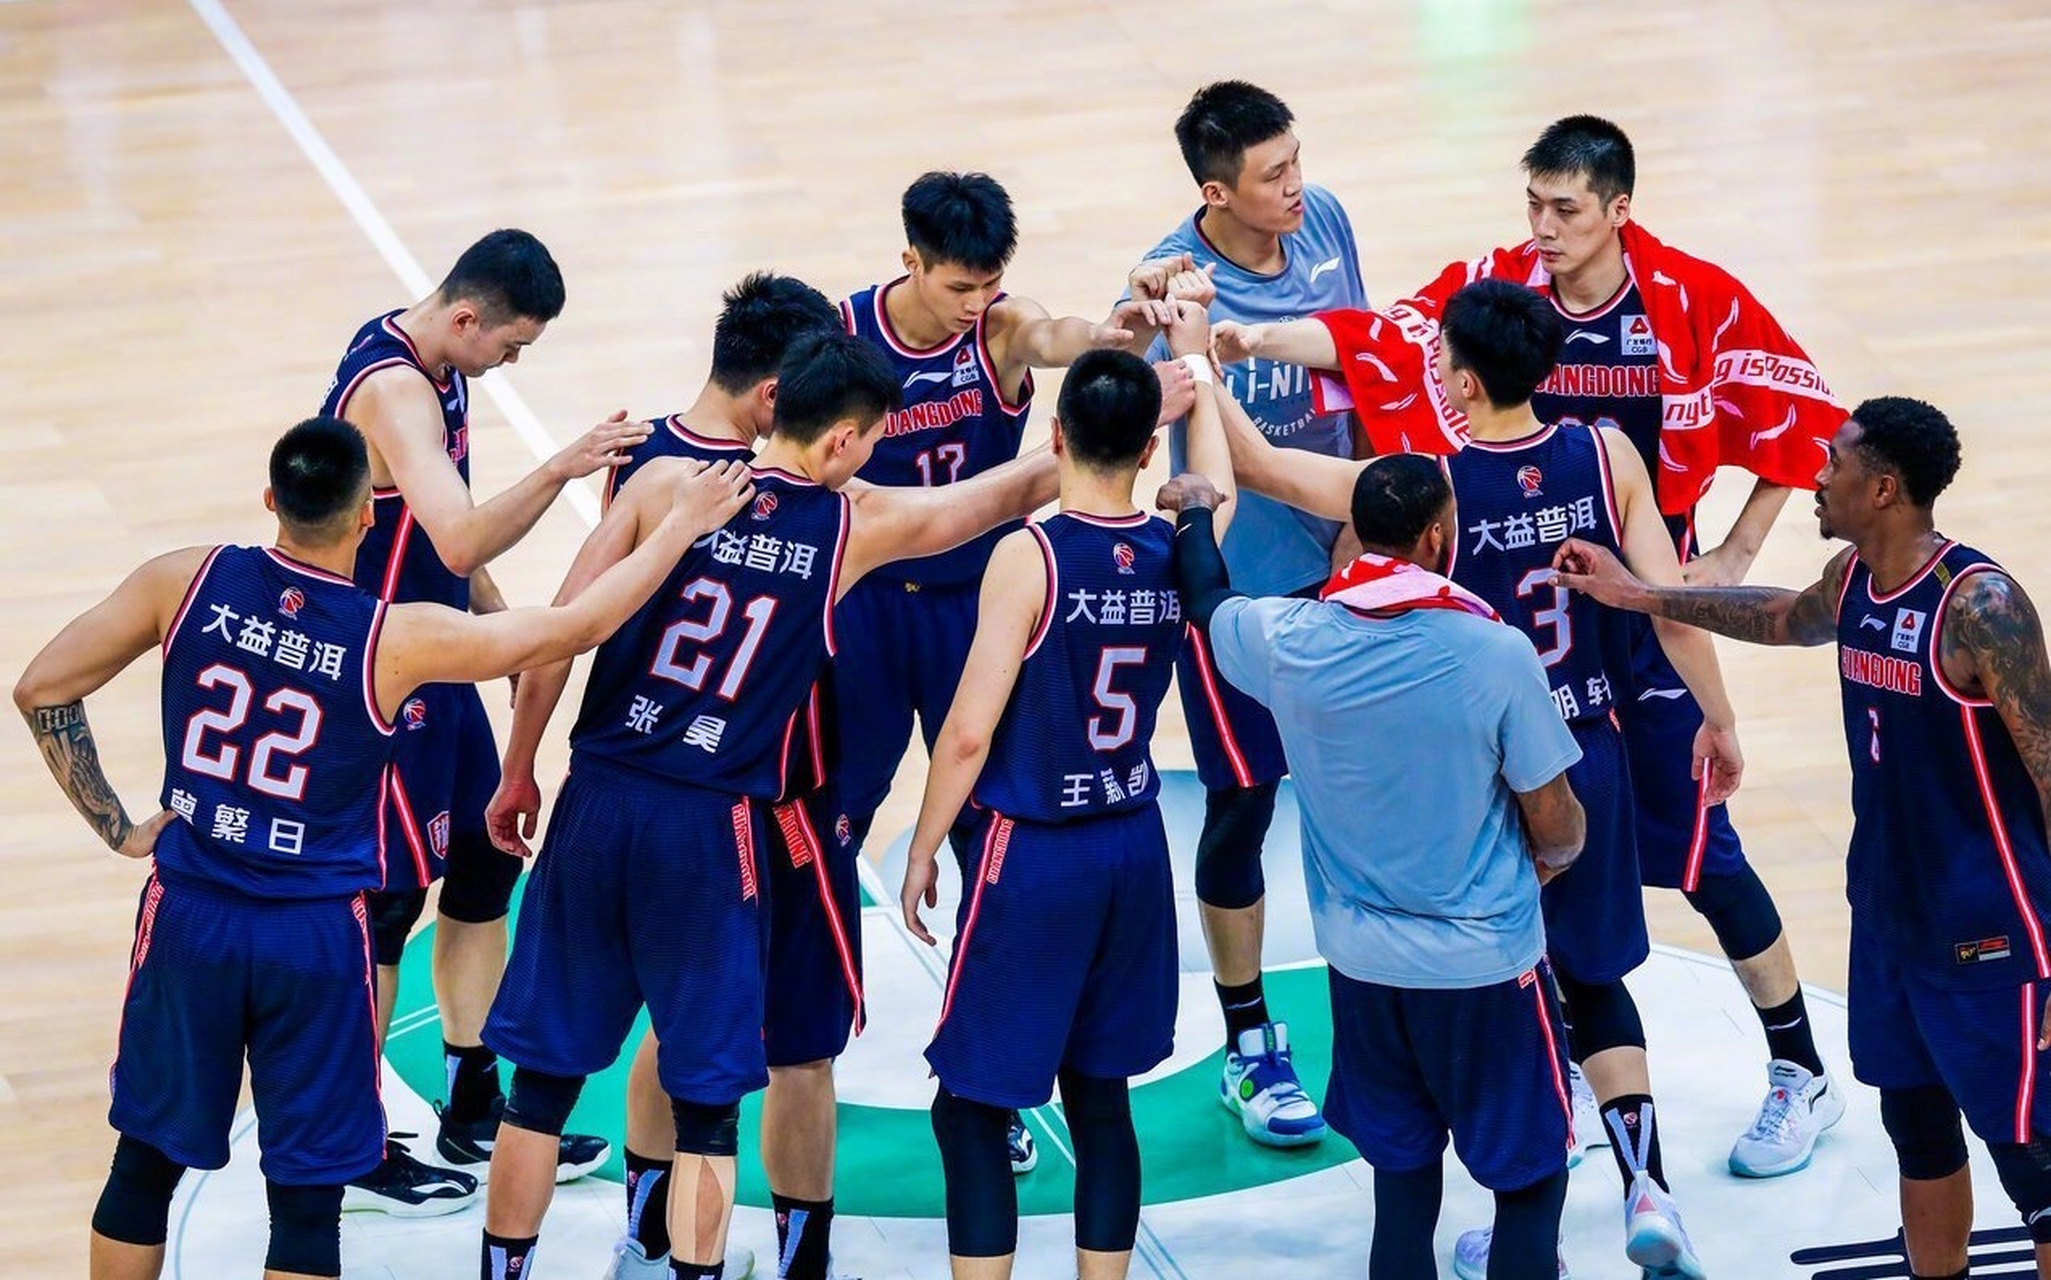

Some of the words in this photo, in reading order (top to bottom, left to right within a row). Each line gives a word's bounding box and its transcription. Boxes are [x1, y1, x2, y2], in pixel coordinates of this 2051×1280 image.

[1226, 364, 1314, 405] LI-NI
[1534, 363, 1660, 398] ANGDONG
[883, 388, 983, 439] UANGDONG
[1252, 406, 1317, 437] BASKETBA
[917, 442, 966, 488] 17
[1469, 495, 1598, 556] 大益普洱
[1065, 588, 1182, 626] 大益普洱
[1515, 565, 1574, 669] 3
[201, 602, 347, 681] 大益普洱
[650, 575, 779, 703] 21
[624, 693, 727, 754] 张昊
[1087, 645, 1148, 752] 5
[180, 661, 324, 804] 22
